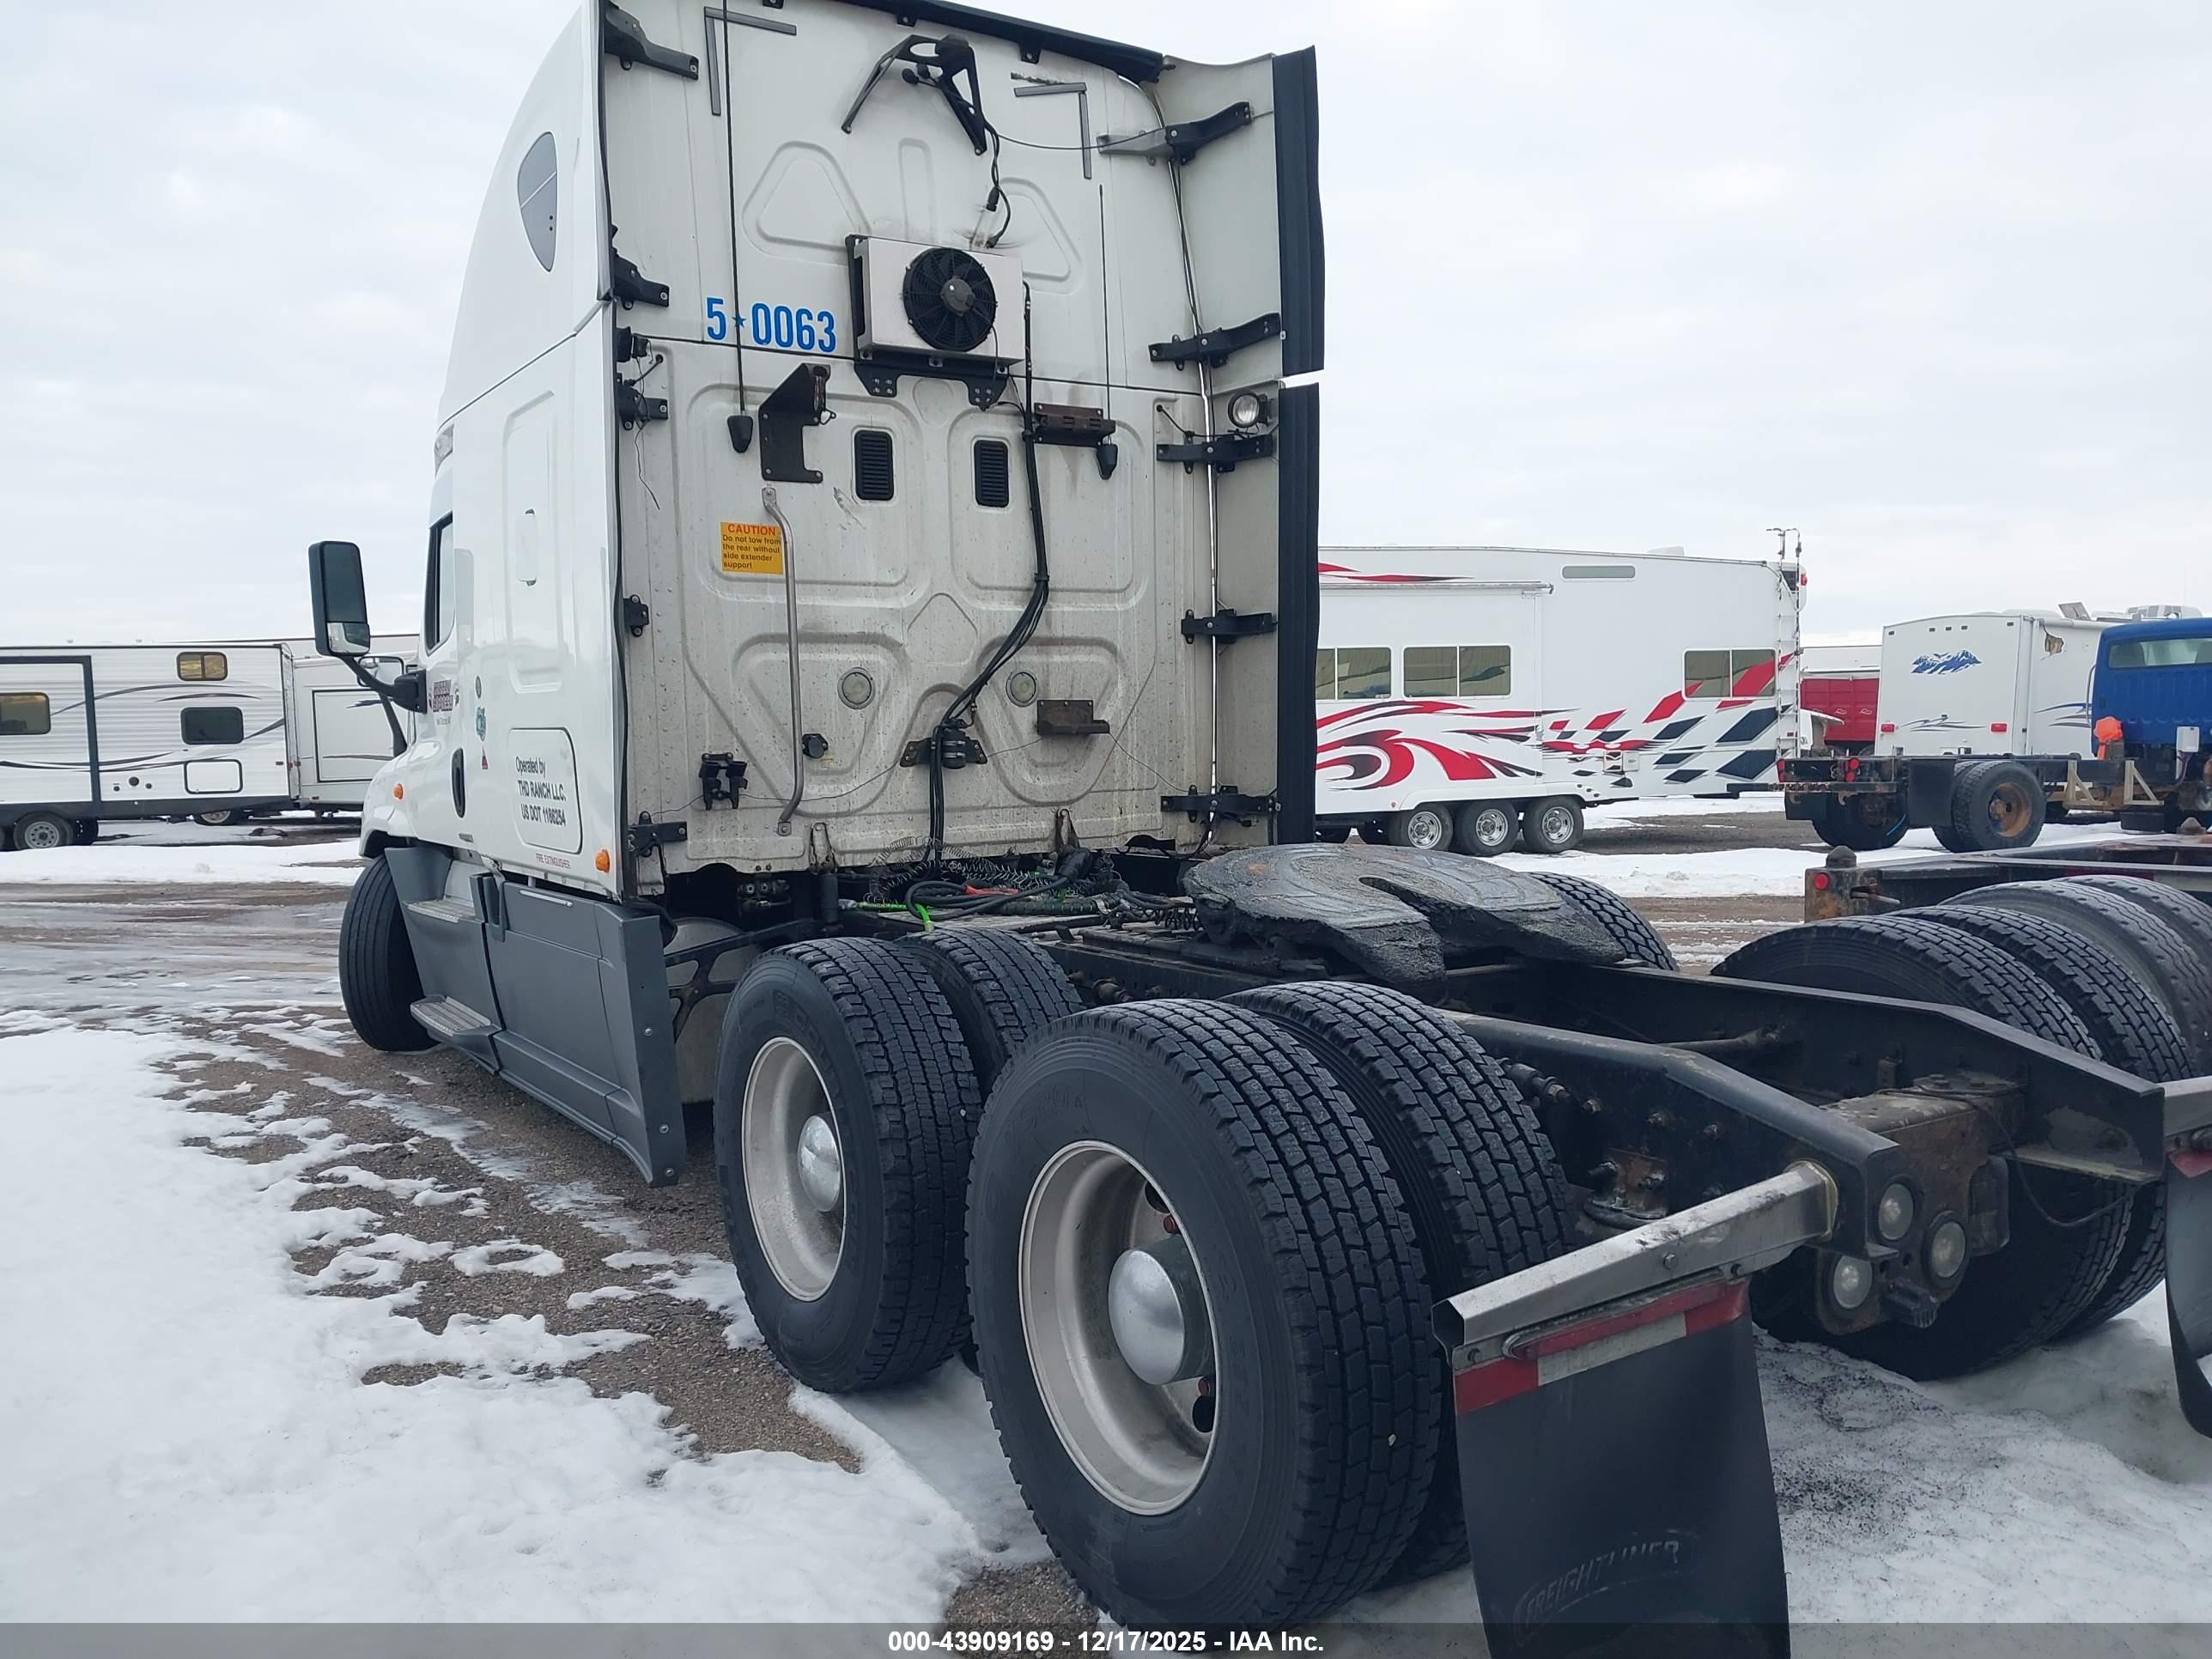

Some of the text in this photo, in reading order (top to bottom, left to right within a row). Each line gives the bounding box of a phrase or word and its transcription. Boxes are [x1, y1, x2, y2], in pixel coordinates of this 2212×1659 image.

[751, 302, 836, 353] 0063
[727, 524, 775, 536] CAUTION
[515, 756, 546, 778] Operated by
[518, 780, 567, 801] THD RANCH LLC.
[521, 804, 530, 820] US
[530, 805, 542, 823] DOT
